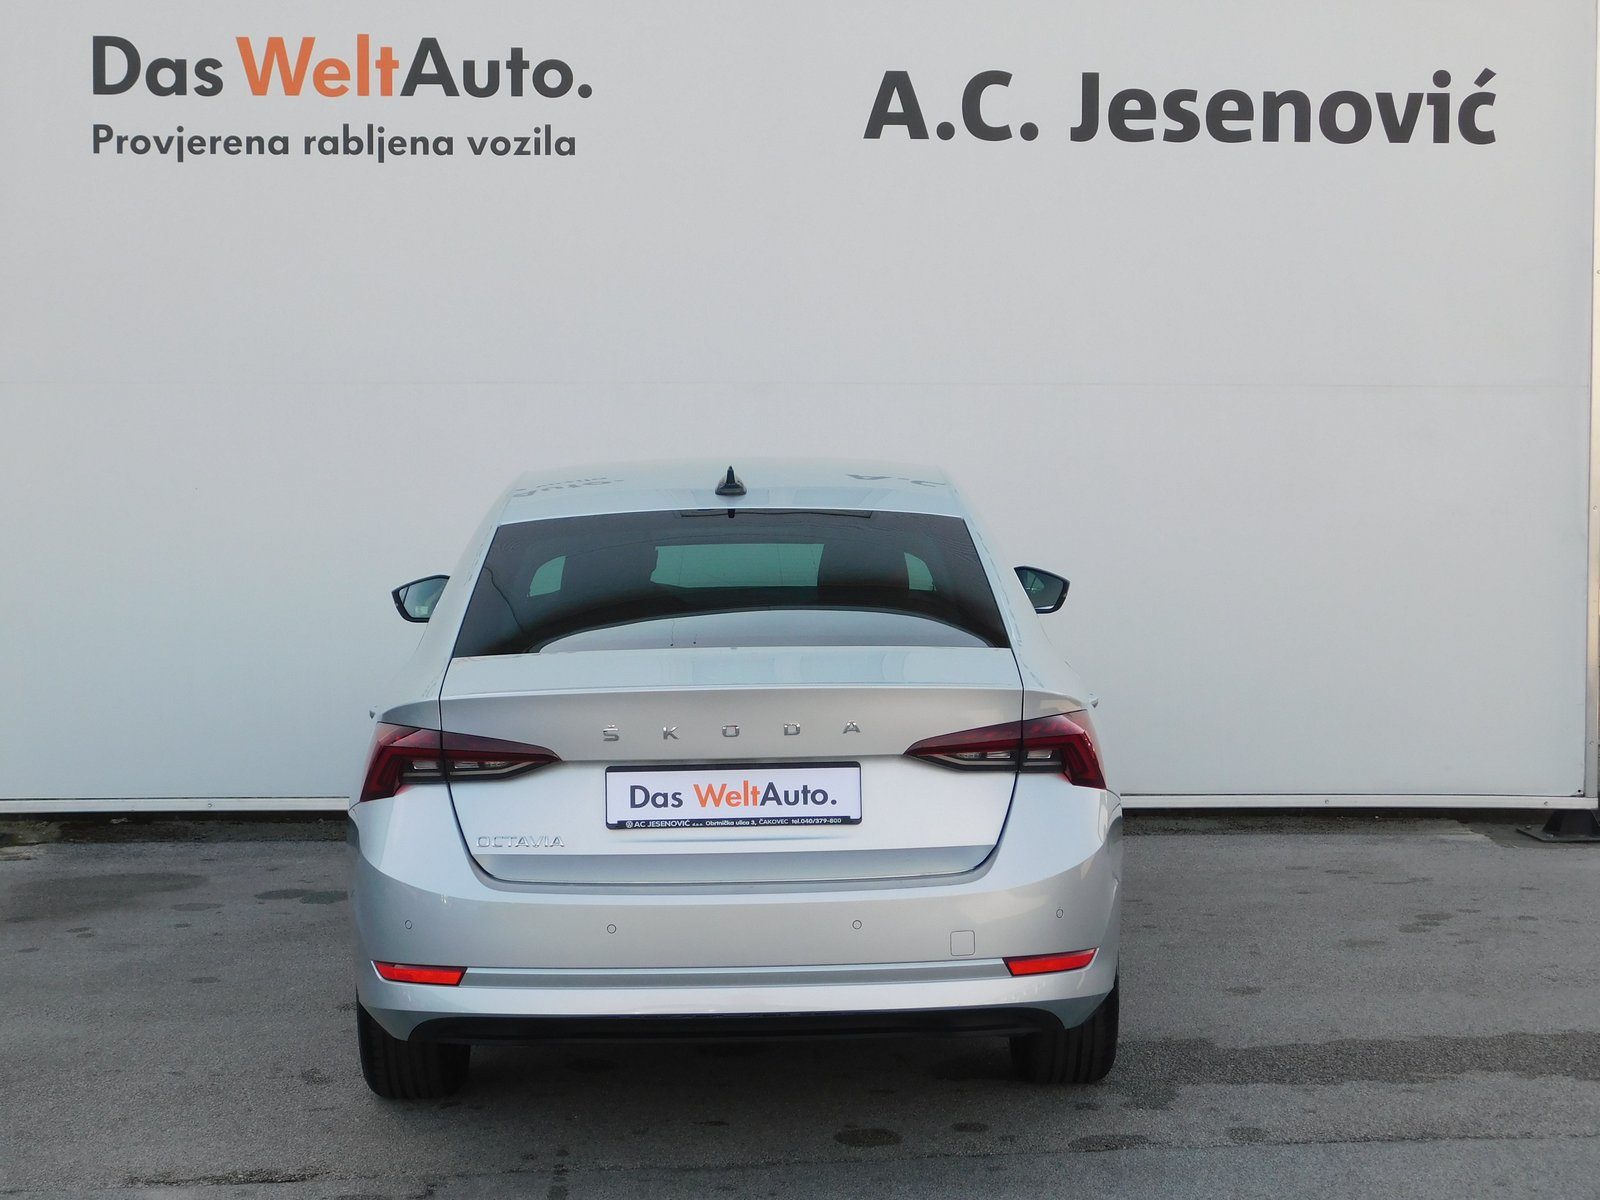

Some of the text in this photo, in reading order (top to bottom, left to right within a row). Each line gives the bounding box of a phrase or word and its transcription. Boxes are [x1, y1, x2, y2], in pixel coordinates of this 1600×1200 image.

[93, 34, 592, 98] Das WeltAuto.
[864, 68, 1496, 145] A.C. Jesenović
[93, 124, 576, 163] Provjerena rabljena vozila
[602, 719, 861, 742] ŠKODA
[630, 780, 837, 808] Das WeltAuto.
[634, 820, 646, 828] AC
[647, 819, 691, 828] JESENOVIĆ
[476, 835, 565, 848] OCTAVIA
